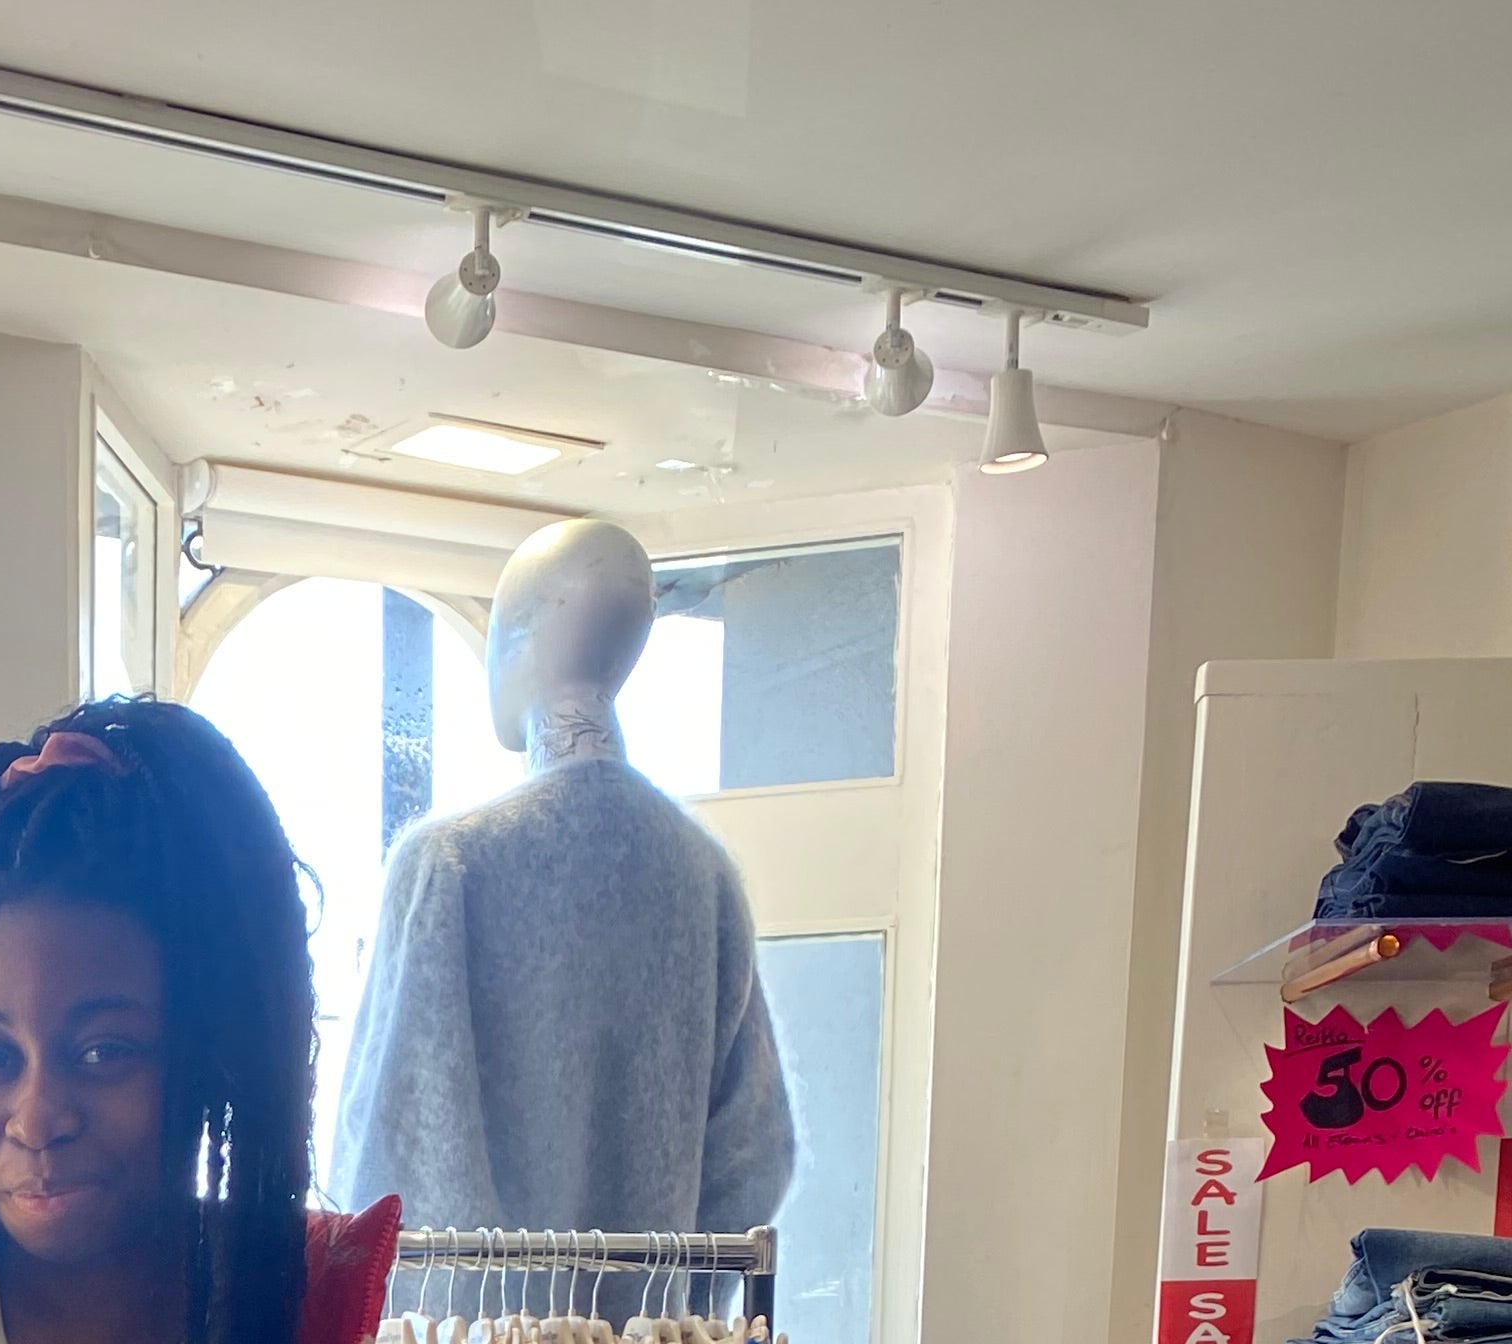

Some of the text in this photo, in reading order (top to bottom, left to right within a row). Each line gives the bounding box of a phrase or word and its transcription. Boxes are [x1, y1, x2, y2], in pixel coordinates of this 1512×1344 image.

[1299, 1045, 1448, 1129] 50 %
[1418, 1087, 1464, 1121] off
[1190, 1148, 1238, 1267] SALE
